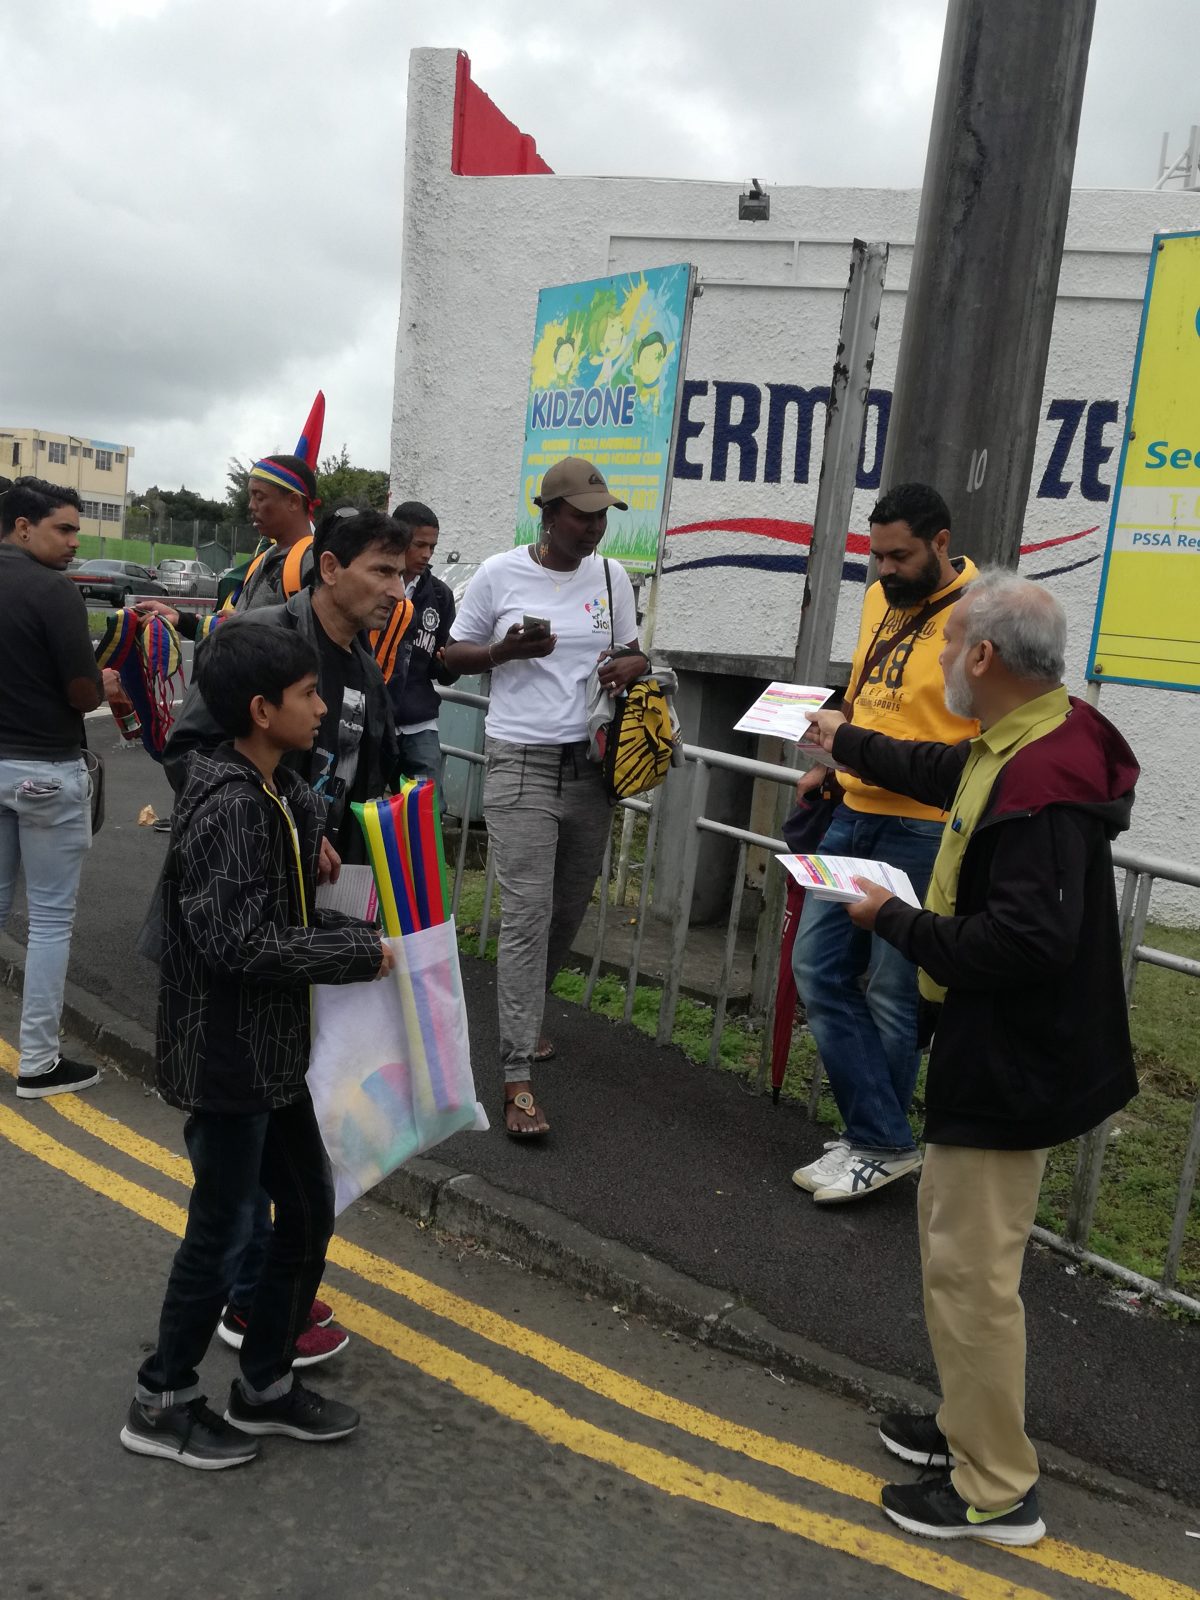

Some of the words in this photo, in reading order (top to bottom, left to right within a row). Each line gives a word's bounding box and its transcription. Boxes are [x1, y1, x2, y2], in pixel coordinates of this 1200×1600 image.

[532, 385, 636, 430] KIDZONE
[966, 448, 987, 492] 10
[1132, 532, 1171, 547] PSSA
[872, 699, 901, 712] SPORTS
